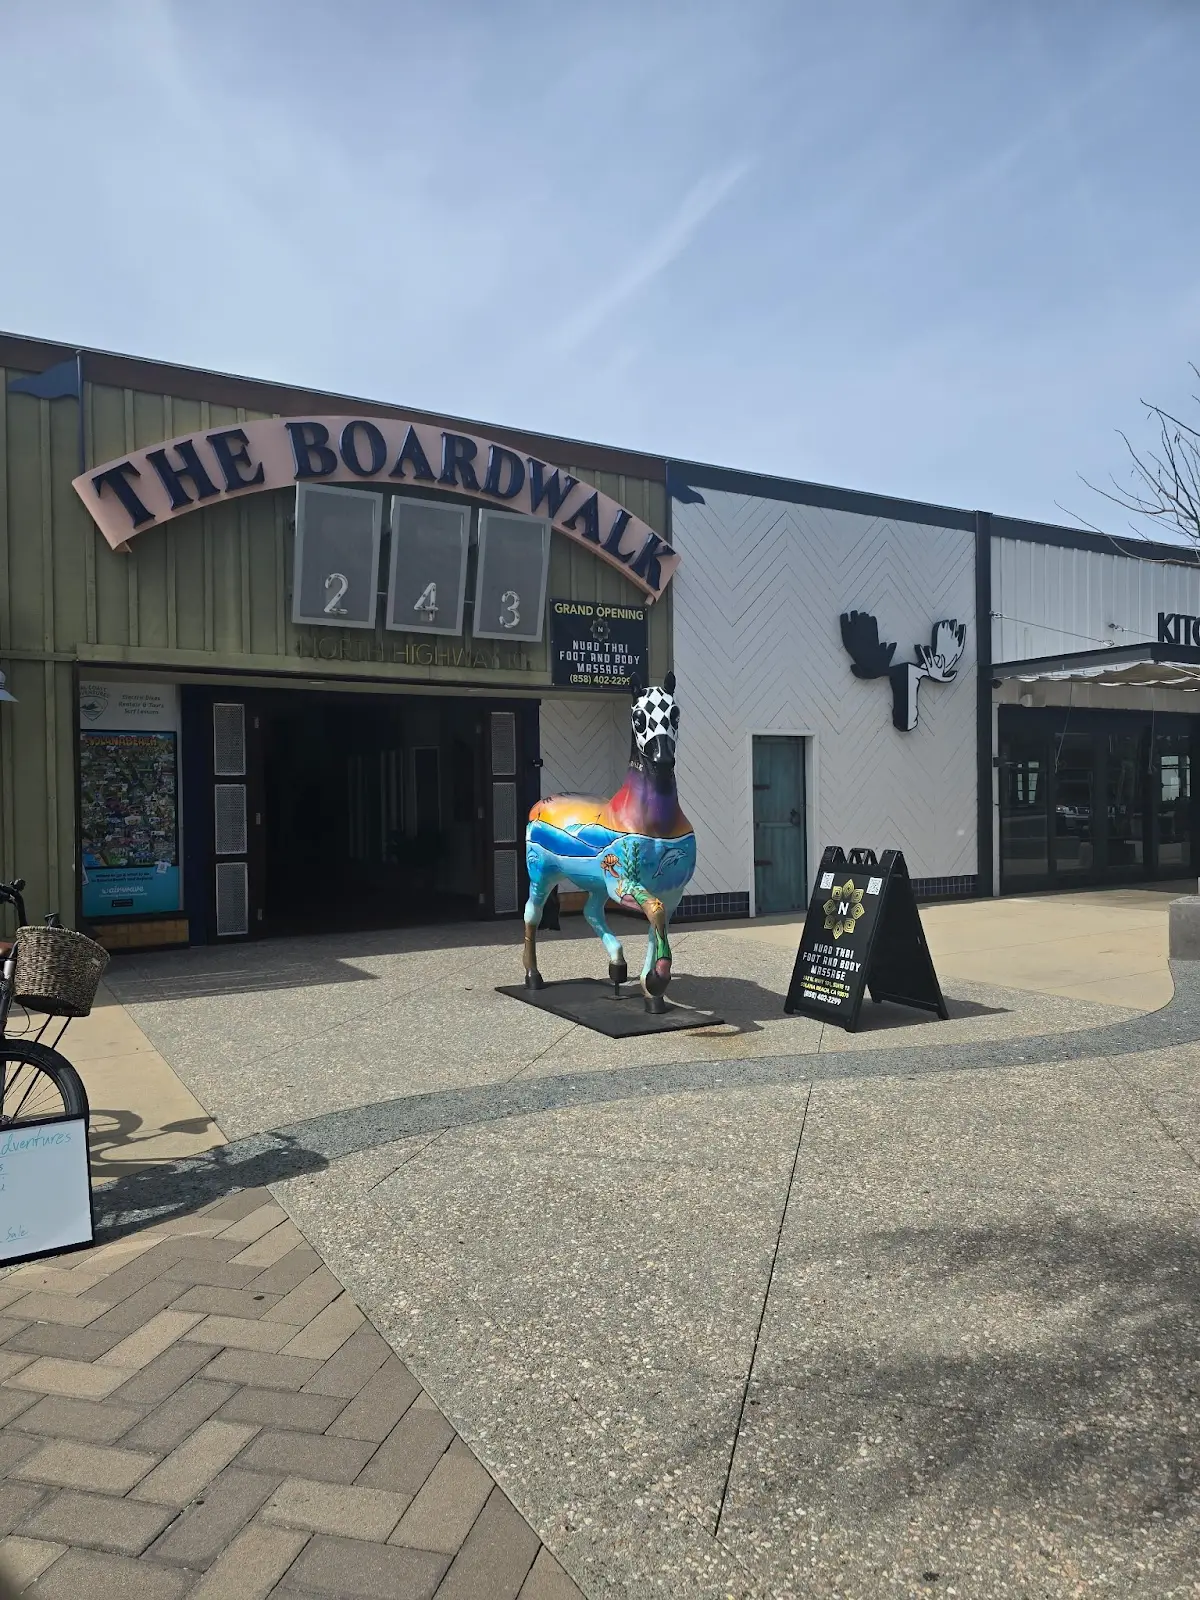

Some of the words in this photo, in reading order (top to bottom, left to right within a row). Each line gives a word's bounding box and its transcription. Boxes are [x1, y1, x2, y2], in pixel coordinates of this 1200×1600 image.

[92, 428, 265, 529] THE
[285, 420, 676, 590] BOARDWALK
[323, 572, 349, 616] 2
[413, 580, 440, 622] 4
[498, 590, 521, 629] 3
[554, 602, 594, 616] GRAND
[596, 606, 644, 620] OPENING
[299, 635, 385, 662] NORTH
[394, 642, 500, 669] HIGHWAY
[572, 640, 600, 651] NUAD
[604, 642, 628, 653] THAI
[559, 651, 586, 661] FOOT
[590, 653, 610, 663] AND
[615, 654, 640, 665] BODY
[577, 663, 625, 675] MASSAGE
[569, 674, 592, 684] (858)
[837, 901, 850, 916] N
[813, 943, 833, 955] NUAD
[835, 947, 854, 959] THAI
[803, 952, 821, 963] FOOT
[822, 956, 838, 968] AND
[840, 960, 862, 973] BODY
[810, 965, 847, 981] MASSAGE
[817, 993, 842, 1006] 402-2299
